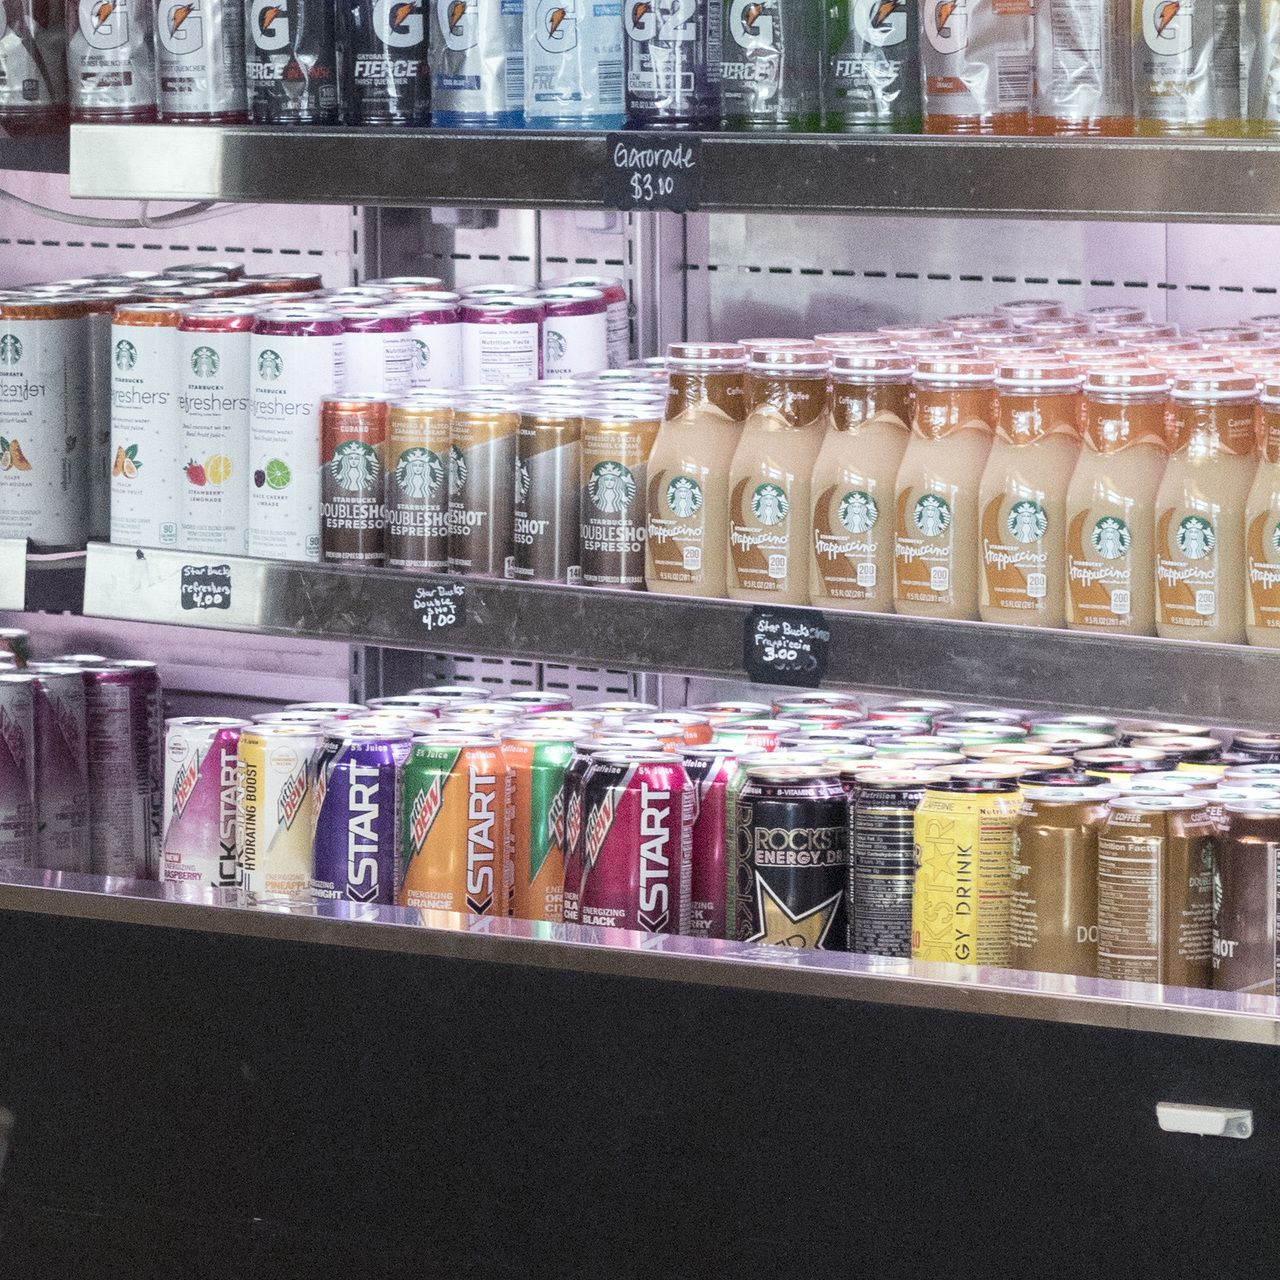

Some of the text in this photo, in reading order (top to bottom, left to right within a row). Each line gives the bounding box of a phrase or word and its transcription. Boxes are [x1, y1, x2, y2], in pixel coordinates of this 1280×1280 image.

[354, 60, 420, 78] FIERCE
[613, 142, 696, 169] Gatorade
[629, 171, 675, 202] $3.10
[340, 425, 369, 433] CUBANO
[332, 496, 377, 504] STARBUCKS
[396, 503, 441, 511] STARBUCKS
[325, 519, 385, 530] ESPRESSO
[390, 526, 448, 537] ESPRESSO
[584, 541, 642, 553] ESPRESSO
[814, 528, 878, 561] frappuccino
[685, 549, 700, 559] 200
[984, 539, 1047, 571] frappuccino
[770, 557, 785, 567] 200
[858, 564, 875, 575] 200
[932, 569, 947, 580] 200
[1068, 554, 1131, 588] frappuccino
[1157, 553, 1215, 588] frappuccino
[1028, 575, 1045, 586] 200
[415, 587, 437, 598] Star
[1112, 592, 1129, 603] 200
[1197, 592, 1214, 603] 200
[192, 591, 223, 607] 4.00
[422, 614, 456, 630] 4.00
[756, 619, 810, 637] Star Bucks
[762, 646, 798, 661] 3.00
[350, 743, 388, 752] 5% Juice
[426, 749, 449, 759] Juice
[681, 760, 707, 769] affeine
[860, 792, 924, 800] Nutrition Fact
[244, 763, 257, 871] HYDRATING BOOST
[1115, 813, 1142, 823] COFFEE
[754, 827, 847, 851] ROCKST
[754, 850, 820, 866] ENERGY
[264, 881, 311, 890] PINEAPPL
[955, 844, 973, 917] DRINK
[407, 889, 454, 900] ENERGIZING
[407, 898, 453, 910] ORANGE
[582, 905, 626, 918] ENERGIZING
[582, 914, 616, 927] BLACK
